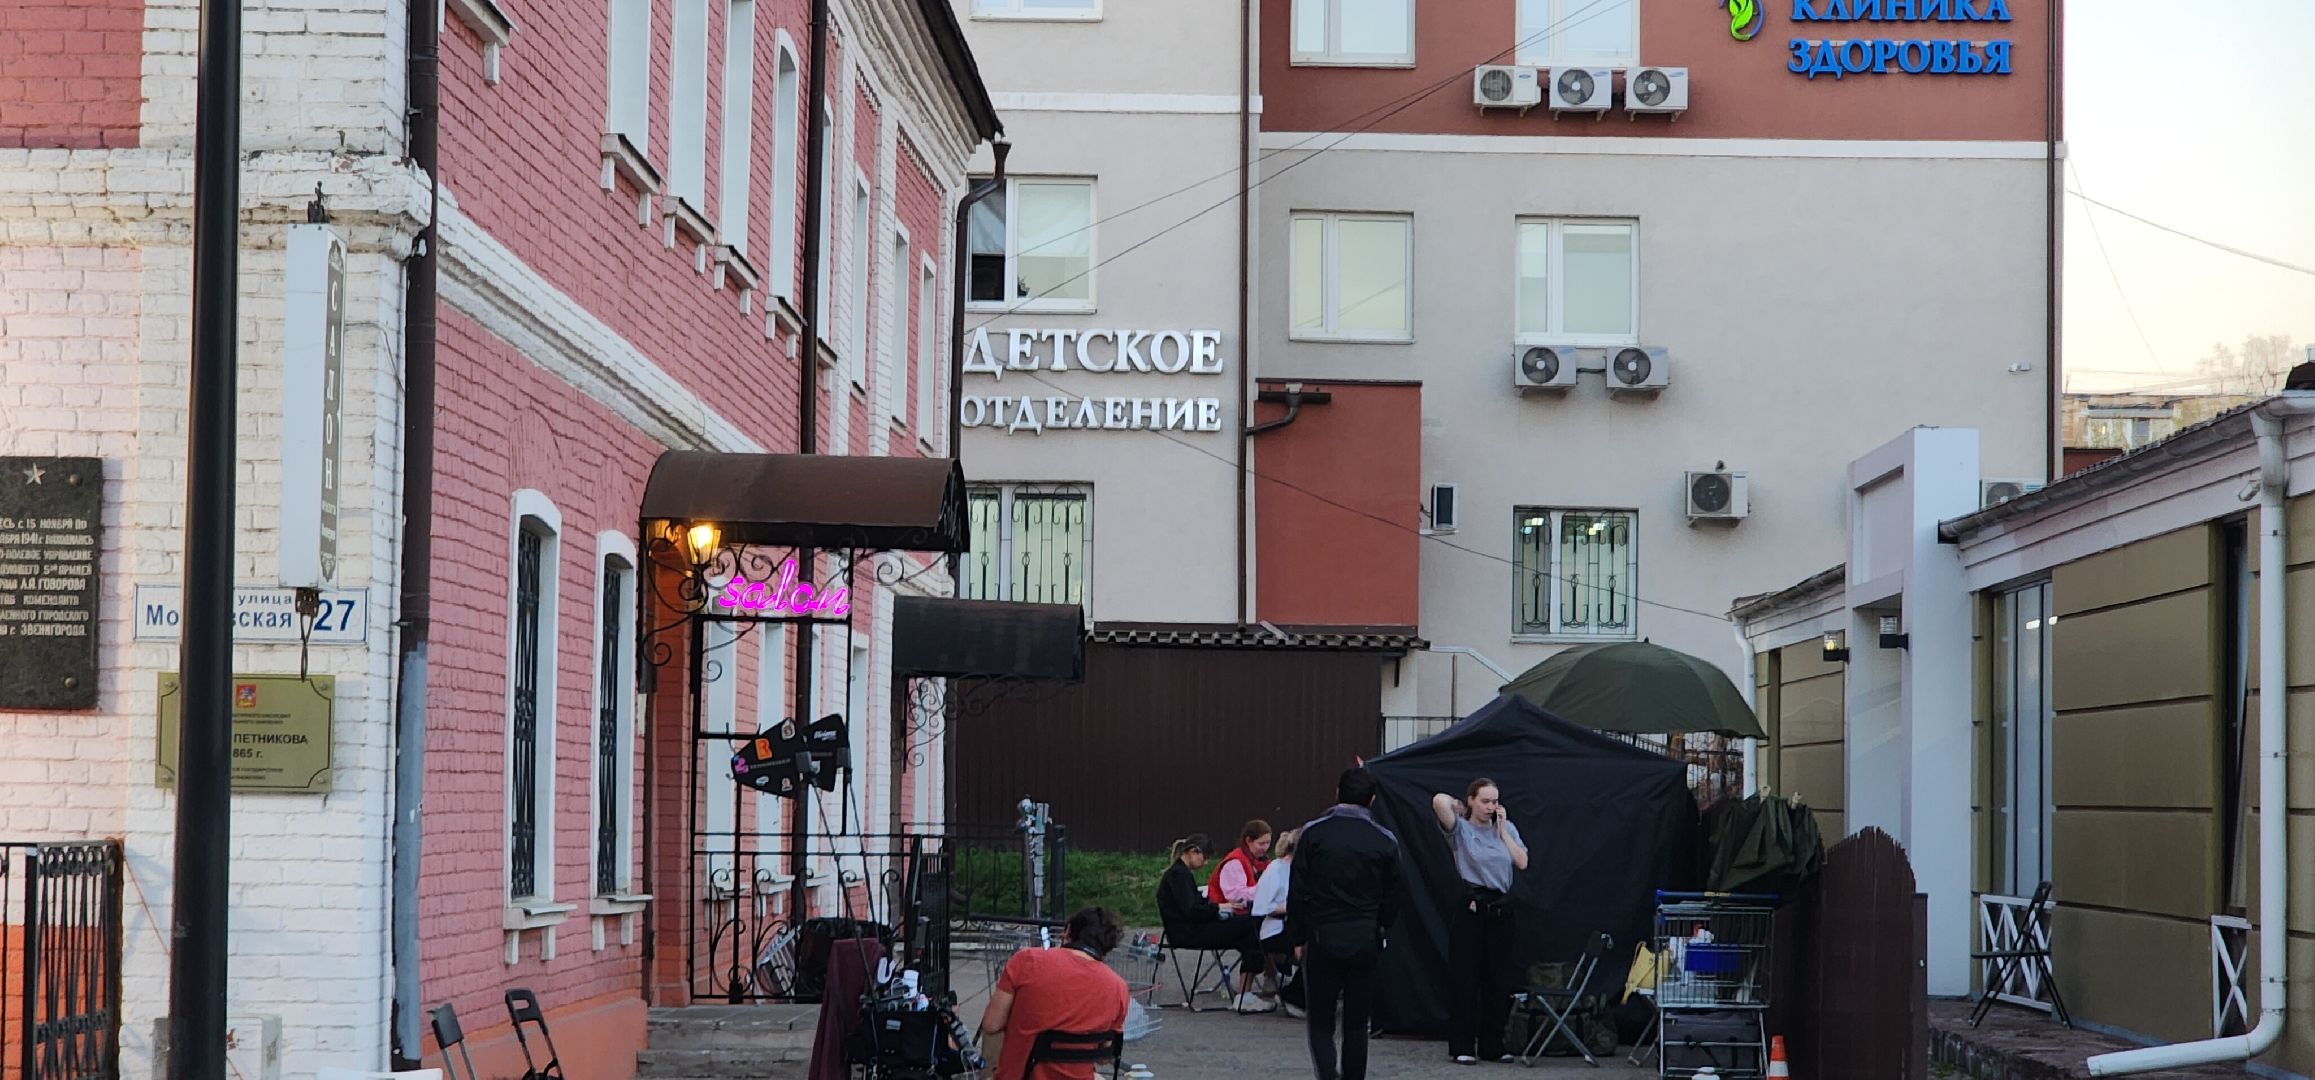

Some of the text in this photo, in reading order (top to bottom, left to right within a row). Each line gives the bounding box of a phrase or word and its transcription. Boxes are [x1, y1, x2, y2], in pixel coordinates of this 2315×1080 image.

[1790, 0, 2013, 21] КЛИНИКА
[1787, 38, 2013, 79] ЗДОРОВЬЯ
[963, 327, 1224, 381] ДЕТСКОЕ
[326, 280, 338, 489] САЛОН
[961, 395, 1222, 436] ОТДЕЛЕНИЕ
[238, 594, 292, 605] улица
[719, 560, 849, 615] salon
[146, 599, 356, 632] Моская 27
